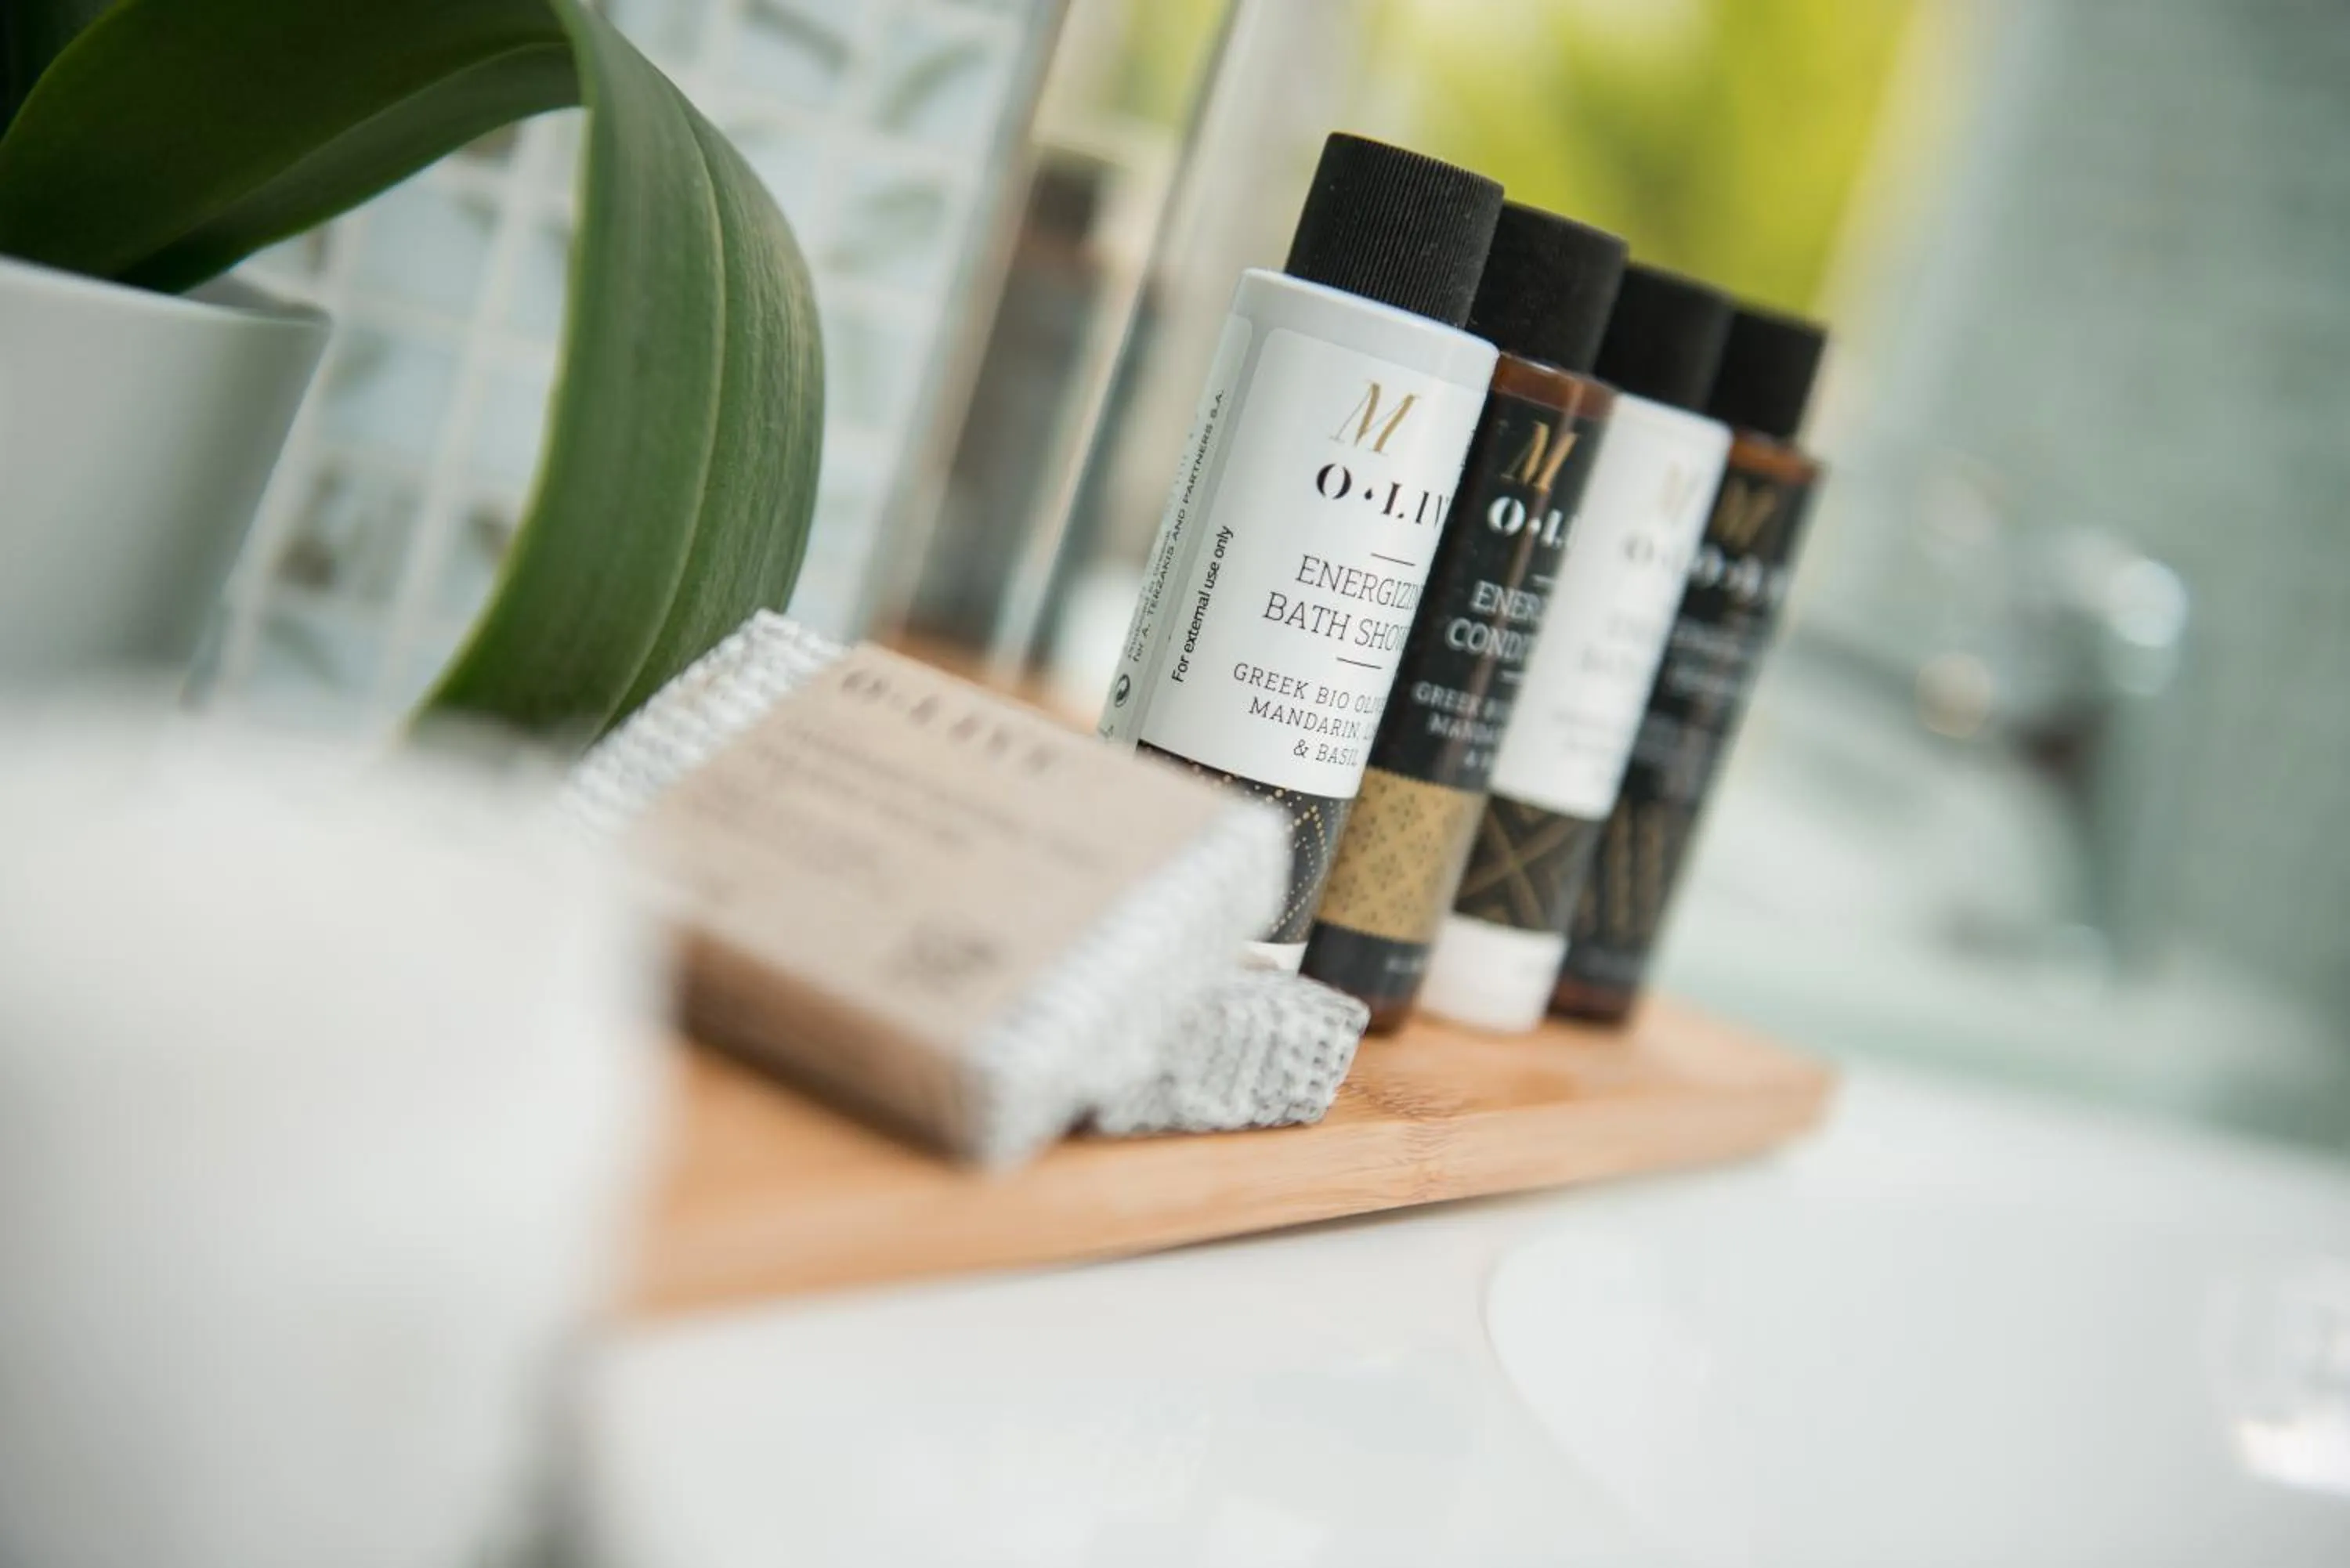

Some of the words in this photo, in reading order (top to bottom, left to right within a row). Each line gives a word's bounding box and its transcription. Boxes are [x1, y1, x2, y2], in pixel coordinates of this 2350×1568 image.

[1329, 380, 1421, 456] M
[1172, 508, 1185, 541] AND
[1182, 423, 1213, 504] PARTNERS
[1171, 655, 1190, 683] For
[1184, 590, 1210, 653] external
[1204, 561, 1220, 590] use
[1214, 525, 1234, 558] only
[1262, 591, 1350, 641] BATH
[1233, 663, 1309, 699] GREEK
[1315, 686, 1350, 709] BIO
[1293, 739, 1309, 758] &
[1315, 743, 1359, 766] BASIL
